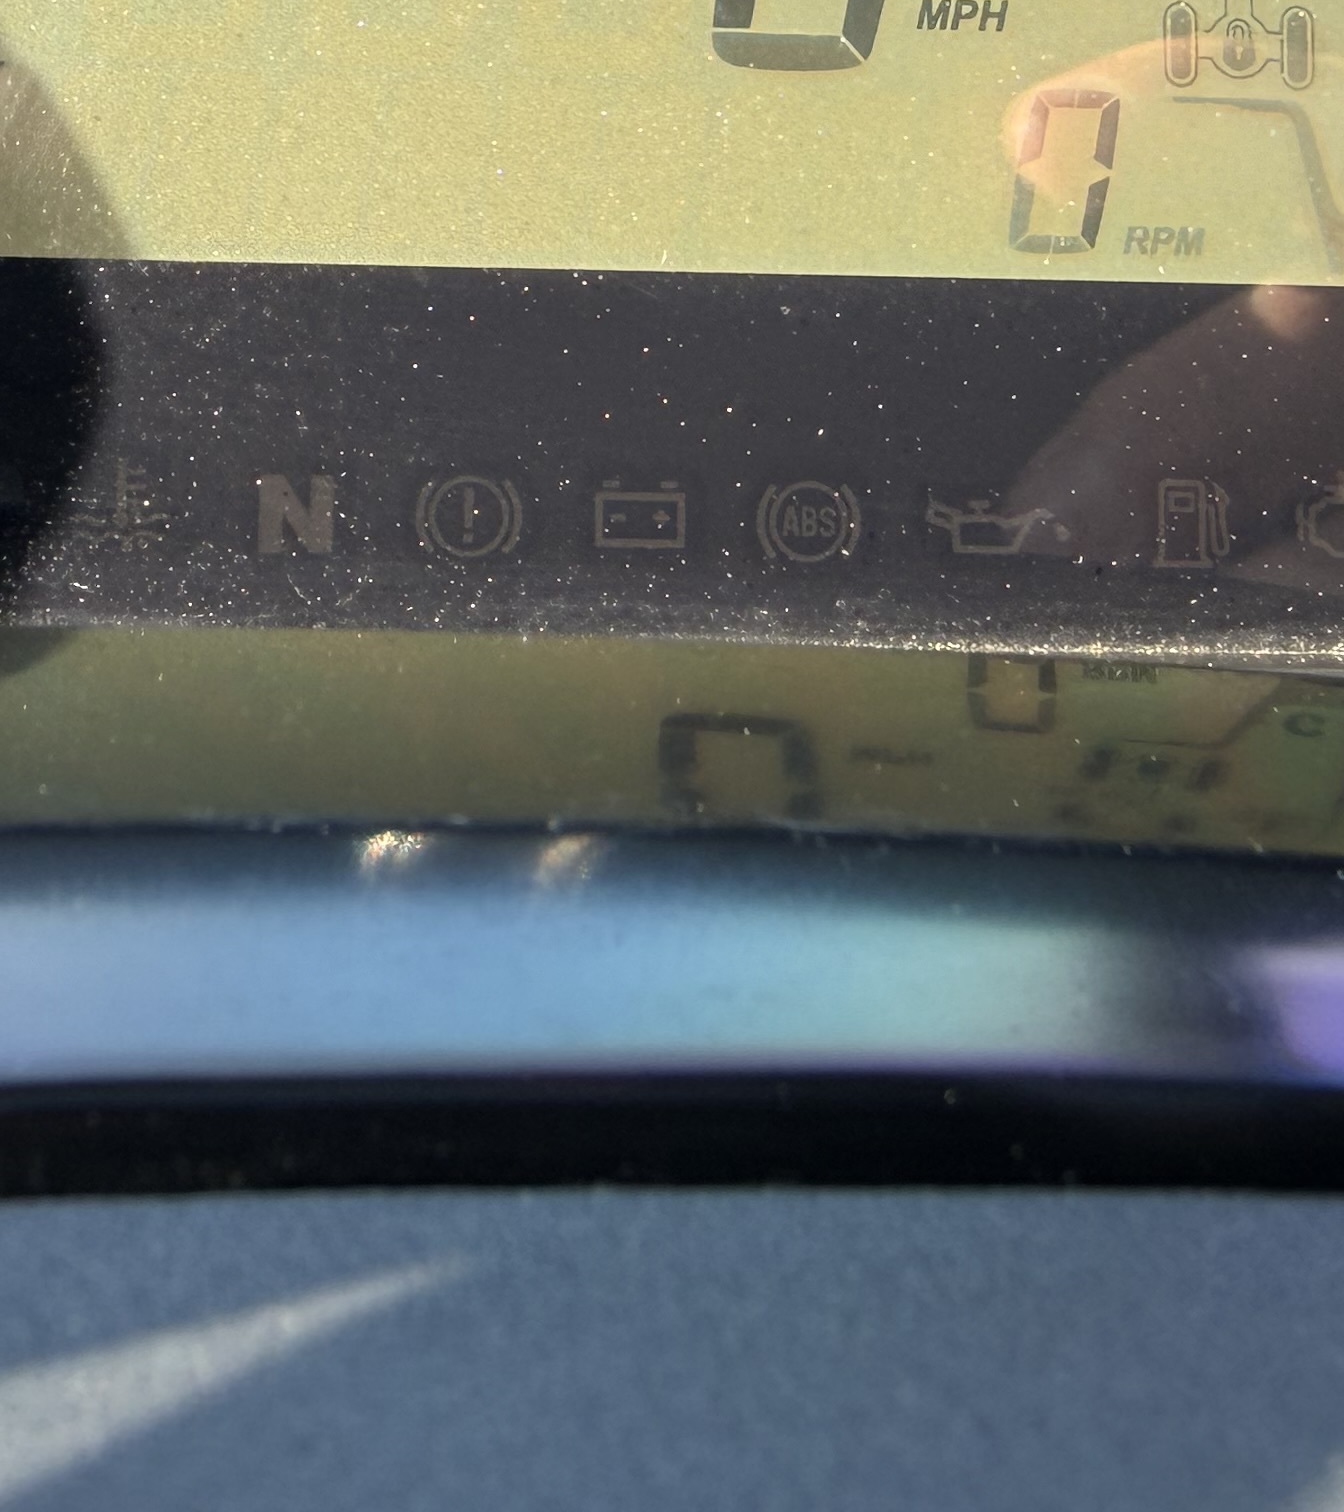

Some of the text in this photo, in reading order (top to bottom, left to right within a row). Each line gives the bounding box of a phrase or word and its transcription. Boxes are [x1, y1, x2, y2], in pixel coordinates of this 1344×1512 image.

[1008, 88, 1206, 258] 0 RPM
[256, 472, 336, 554] N
[781, 504, 837, 538] ABS
